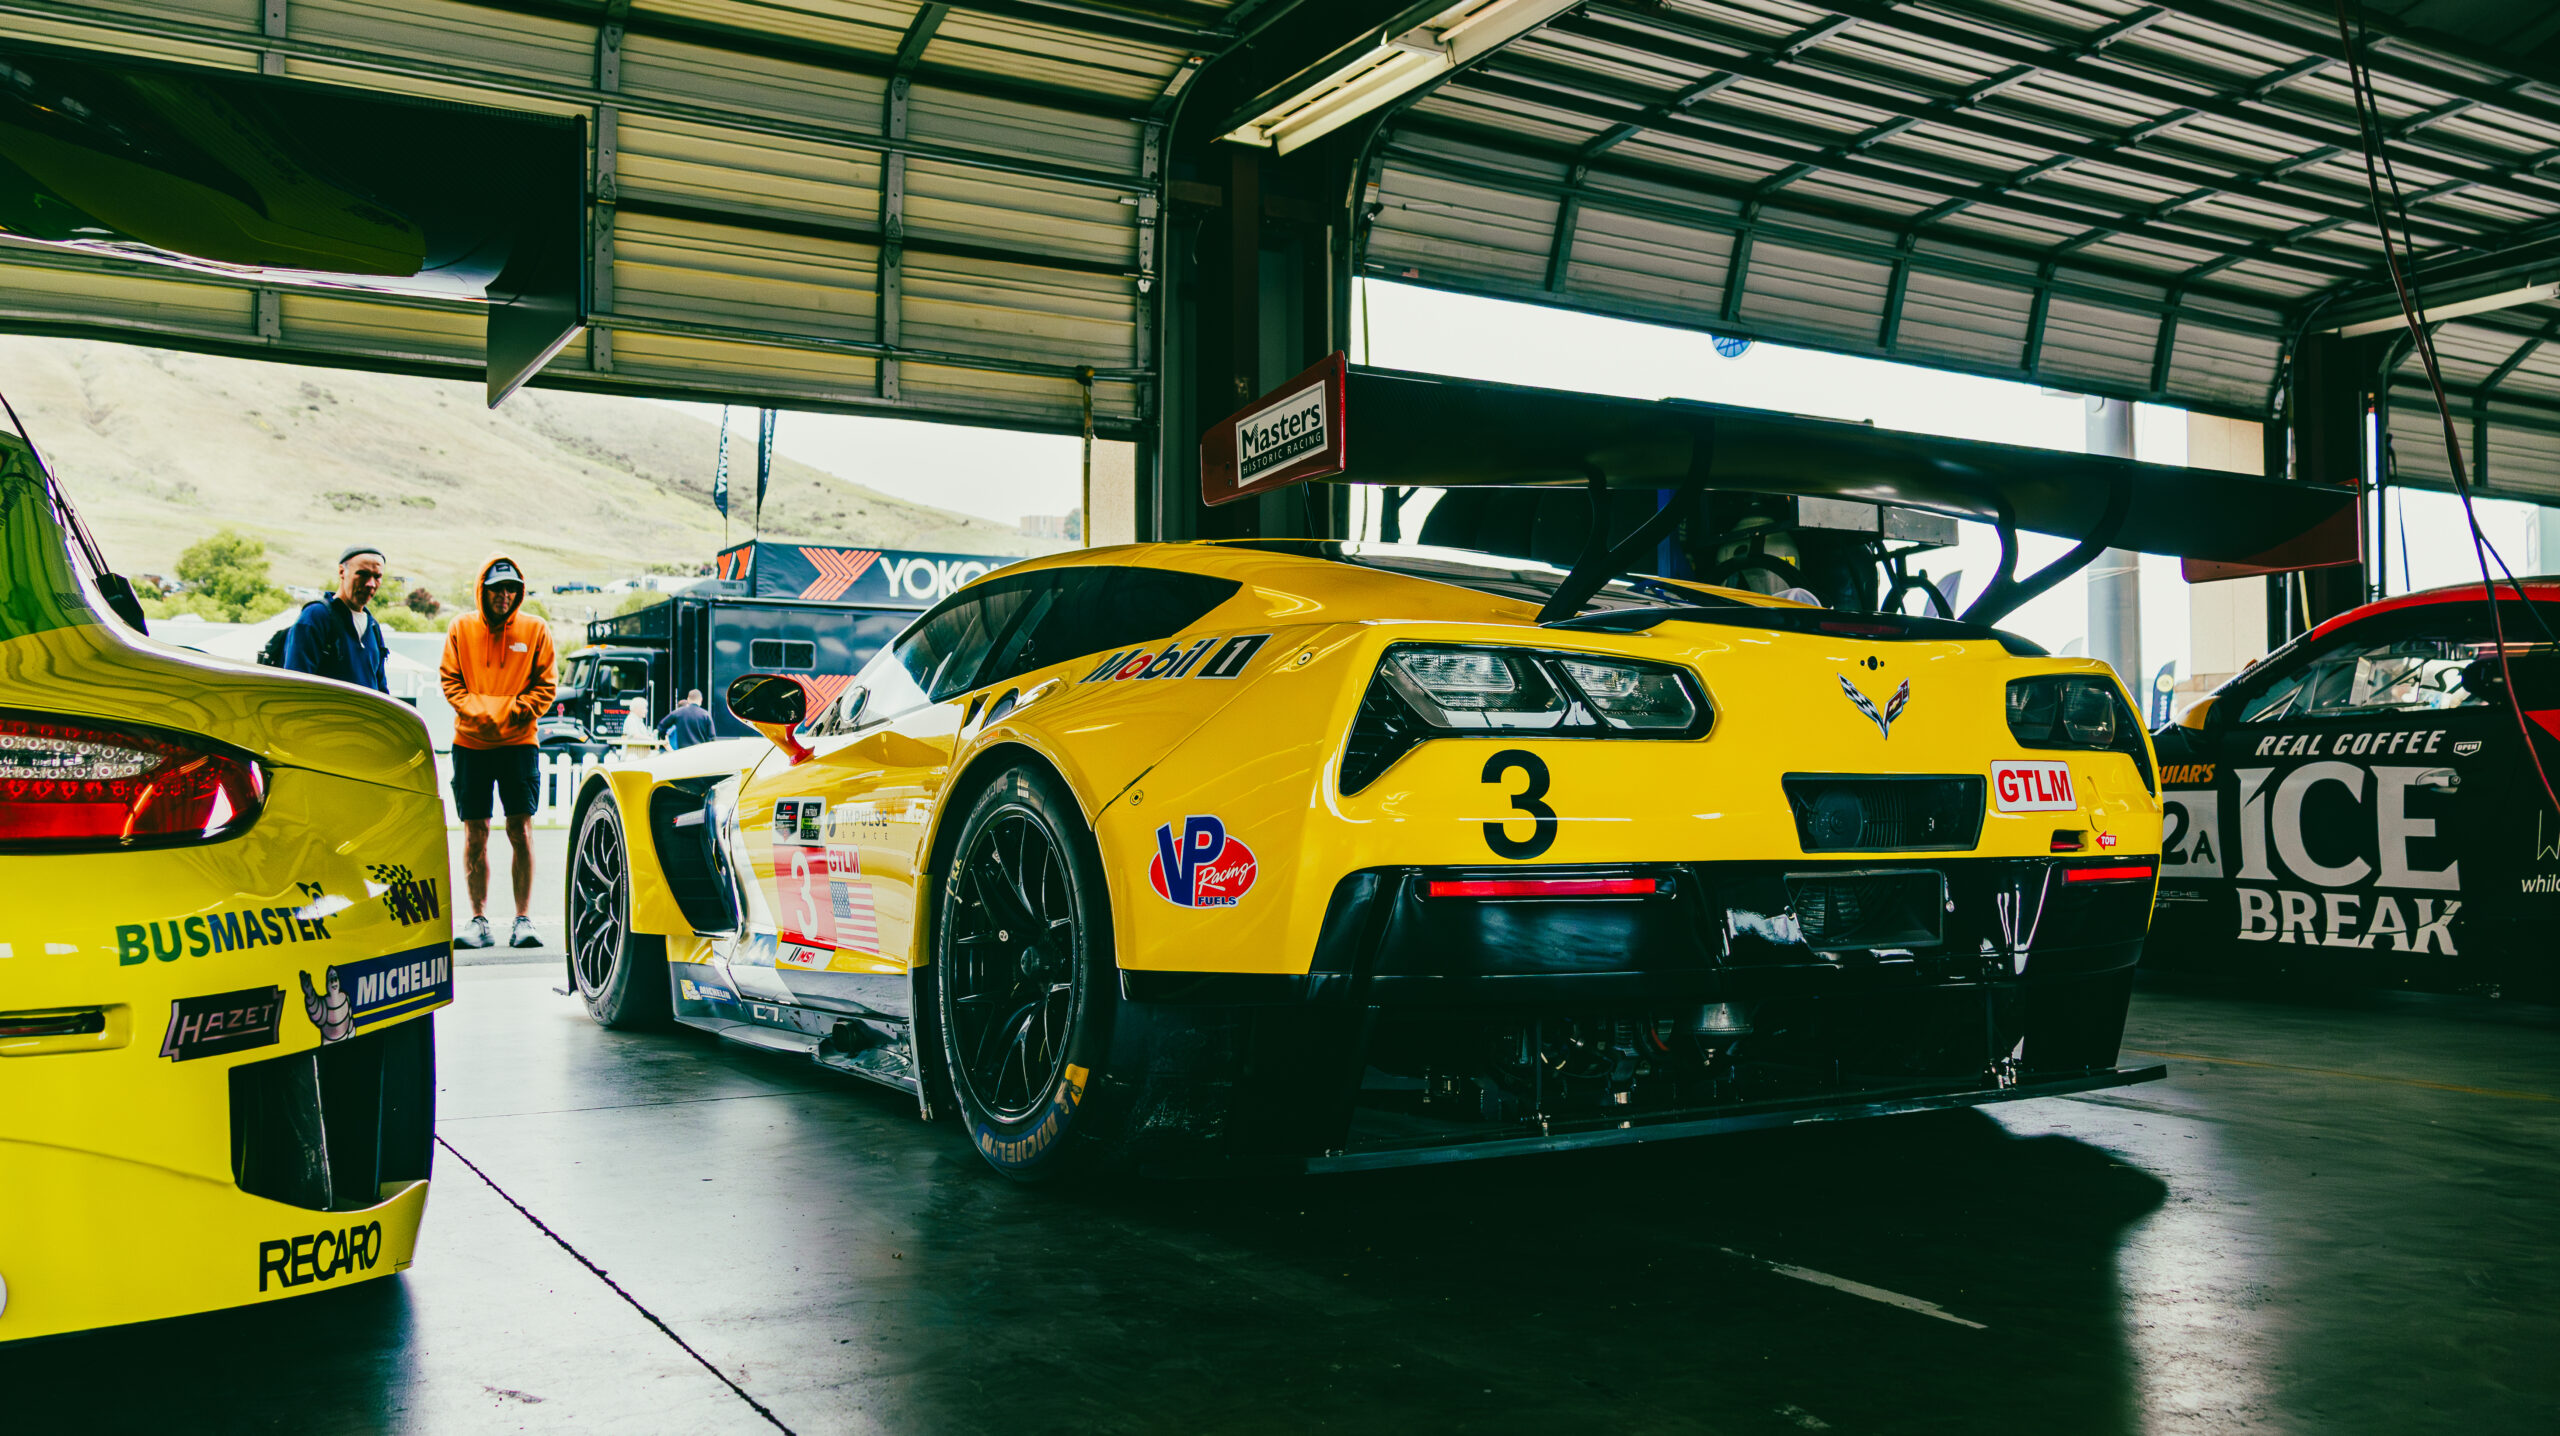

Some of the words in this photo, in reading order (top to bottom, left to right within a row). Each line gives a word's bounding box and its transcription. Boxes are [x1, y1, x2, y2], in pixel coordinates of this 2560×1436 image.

[1241, 403, 1321, 459] Masters
[1242, 449, 1284, 475] HISTORIC
[1287, 432, 1321, 455] RACING
[879, 556, 1000, 600] YOKO
[1075, 636, 1221, 685] Mobil
[2255, 733, 2320, 756] REAL
[2333, 730, 2446, 756] COFFEE
[2457, 743, 2478, 751] OPEN
[1998, 769, 2073, 803] GTLM
[2158, 763, 2216, 785] UIAR'S
[842, 808, 888, 827] IMPULSE
[1481, 749, 1558, 860] 3
[2234, 760, 2461, 891] ICE
[829, 850, 860, 874] GTLM
[1156, 815, 1226, 908] VP
[2101, 836, 2116, 846] TOW
[791, 851, 818, 941] 3
[1198, 860, 1257, 895] Racing
[1198, 896, 1237, 906] FUELS
[2236, 888, 2462, 956] BREAK
[115, 905, 331, 967] BUSMASTER
[356, 956, 449, 1007] MICHELIN
[178, 1003, 275, 1047] HAZET
[982, 1111, 1058, 1163] MICHELIN
[259, 1220, 382, 1292] RECARO
